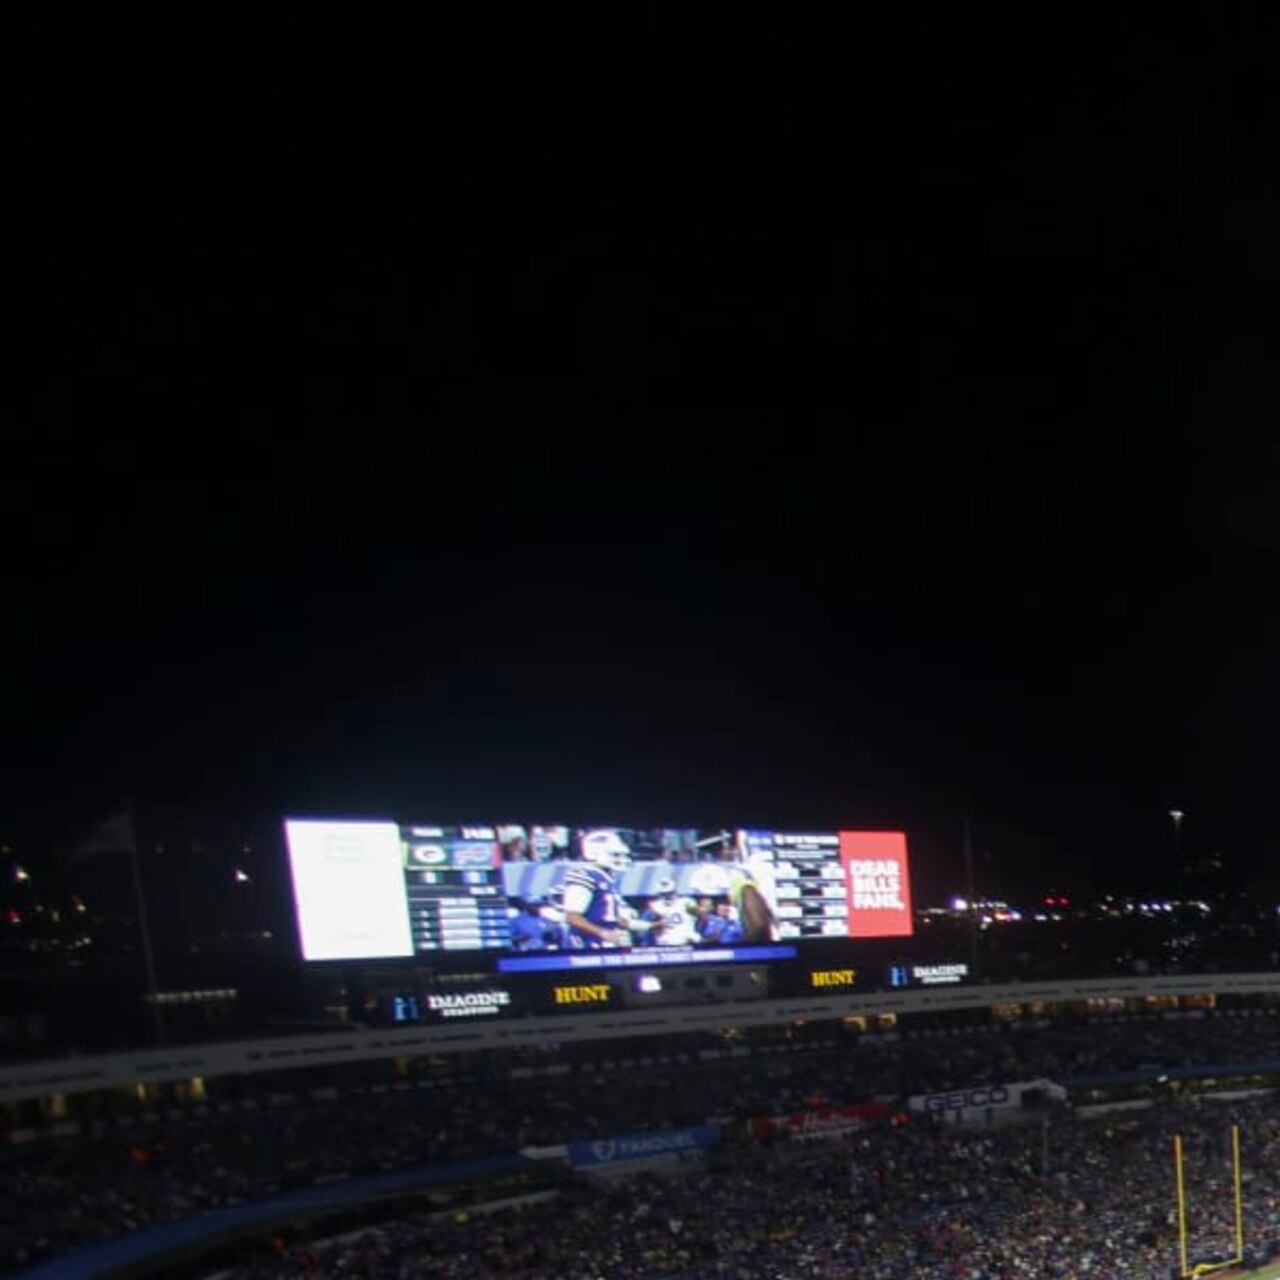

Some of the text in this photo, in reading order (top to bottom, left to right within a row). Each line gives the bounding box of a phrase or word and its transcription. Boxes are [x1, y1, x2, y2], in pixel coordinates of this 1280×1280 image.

[850, 859, 901, 875] DEAR
[852, 875, 901, 893] BILLS
[811, 970, 855, 987] HUNT
[913, 963, 968, 979] IMAGINE
[427, 991, 510, 1011] IMAGINE
[555, 984, 611, 1004] HUNT
[925, 1091, 1008, 1111] GEICO
